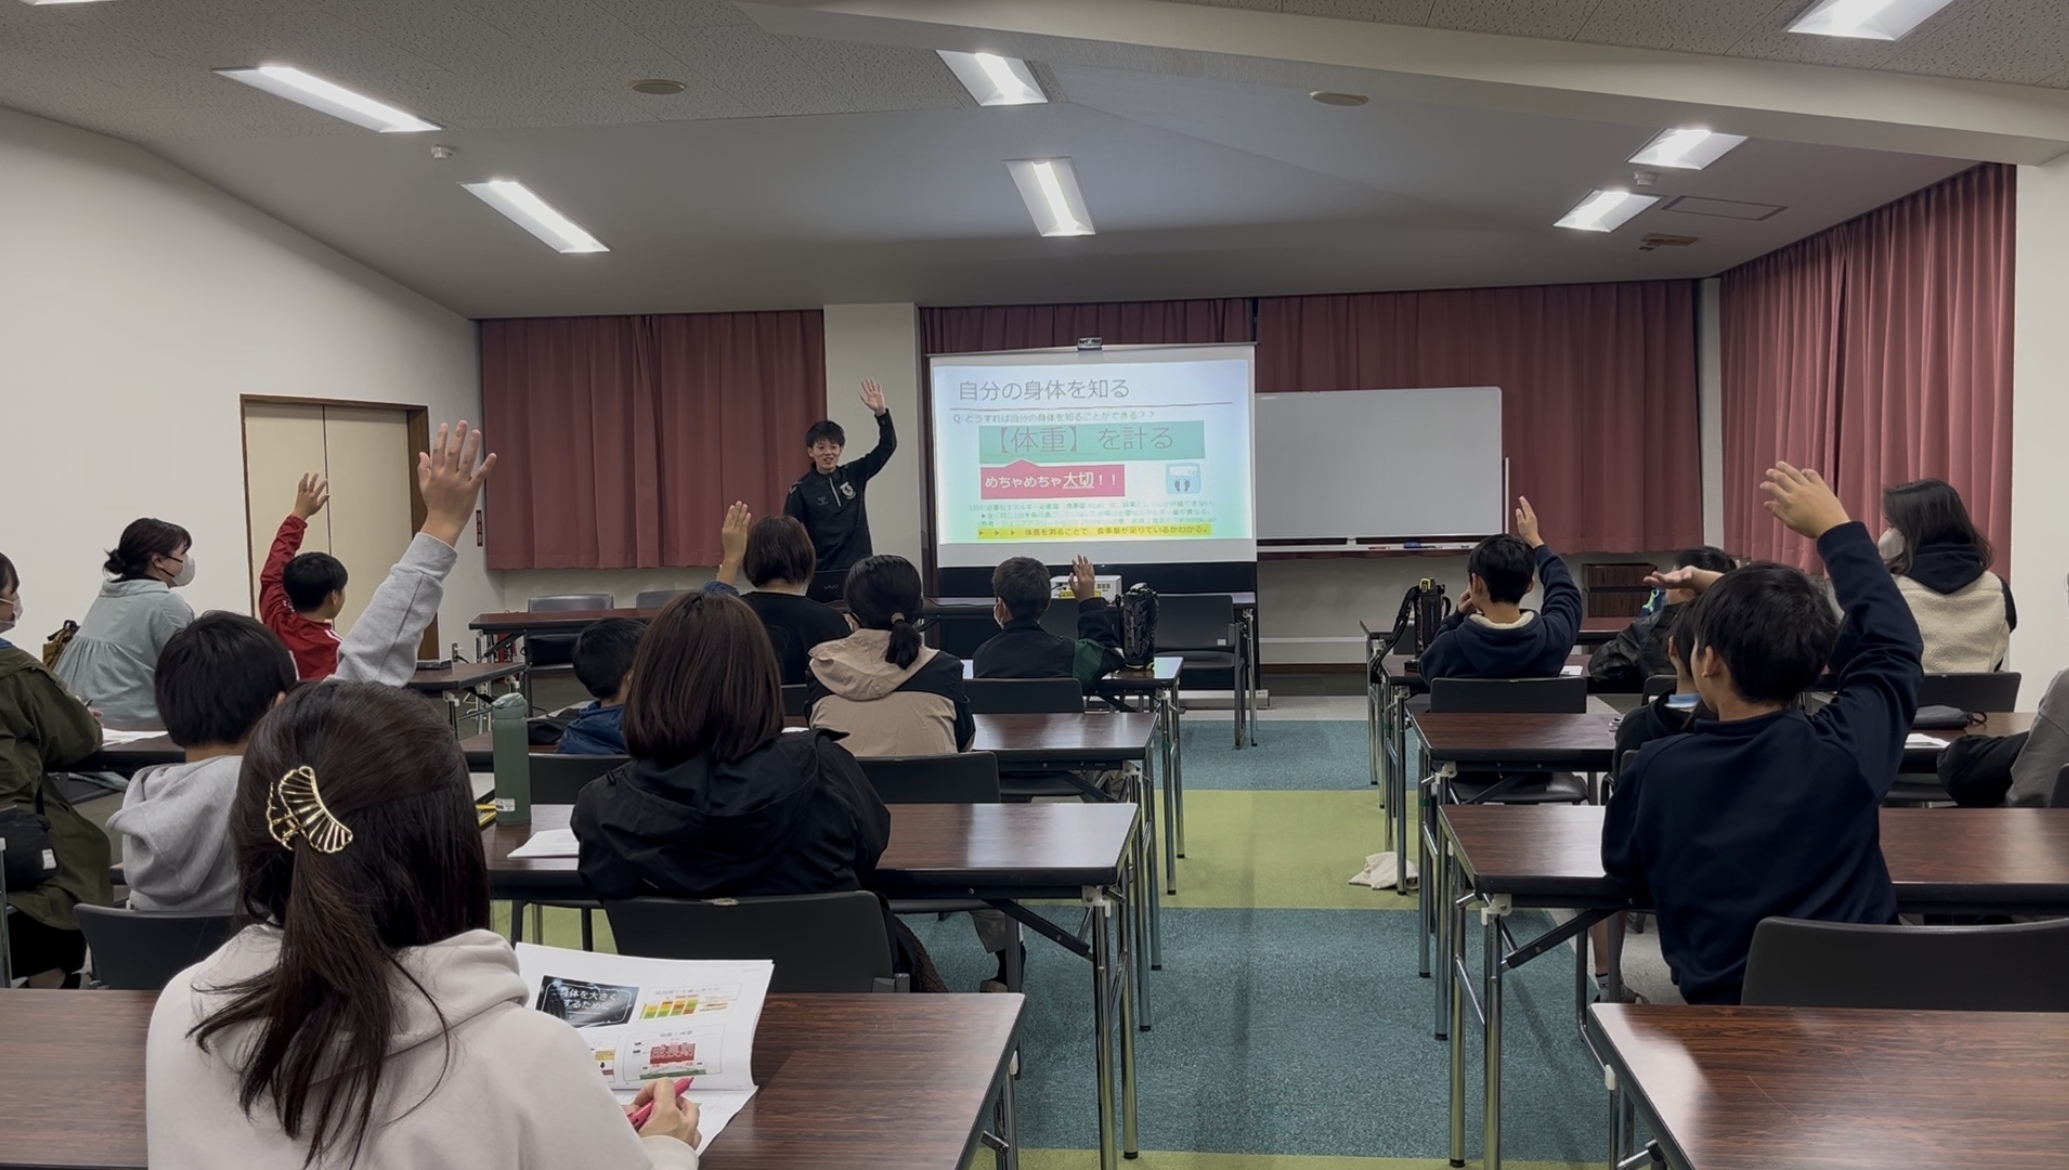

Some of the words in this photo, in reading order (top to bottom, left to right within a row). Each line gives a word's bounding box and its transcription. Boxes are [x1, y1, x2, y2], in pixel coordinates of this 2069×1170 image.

[959, 378, 1131, 402] 自分の身体を知る
[984, 471, 1117, 490] めちゃめちゃ大切！！
